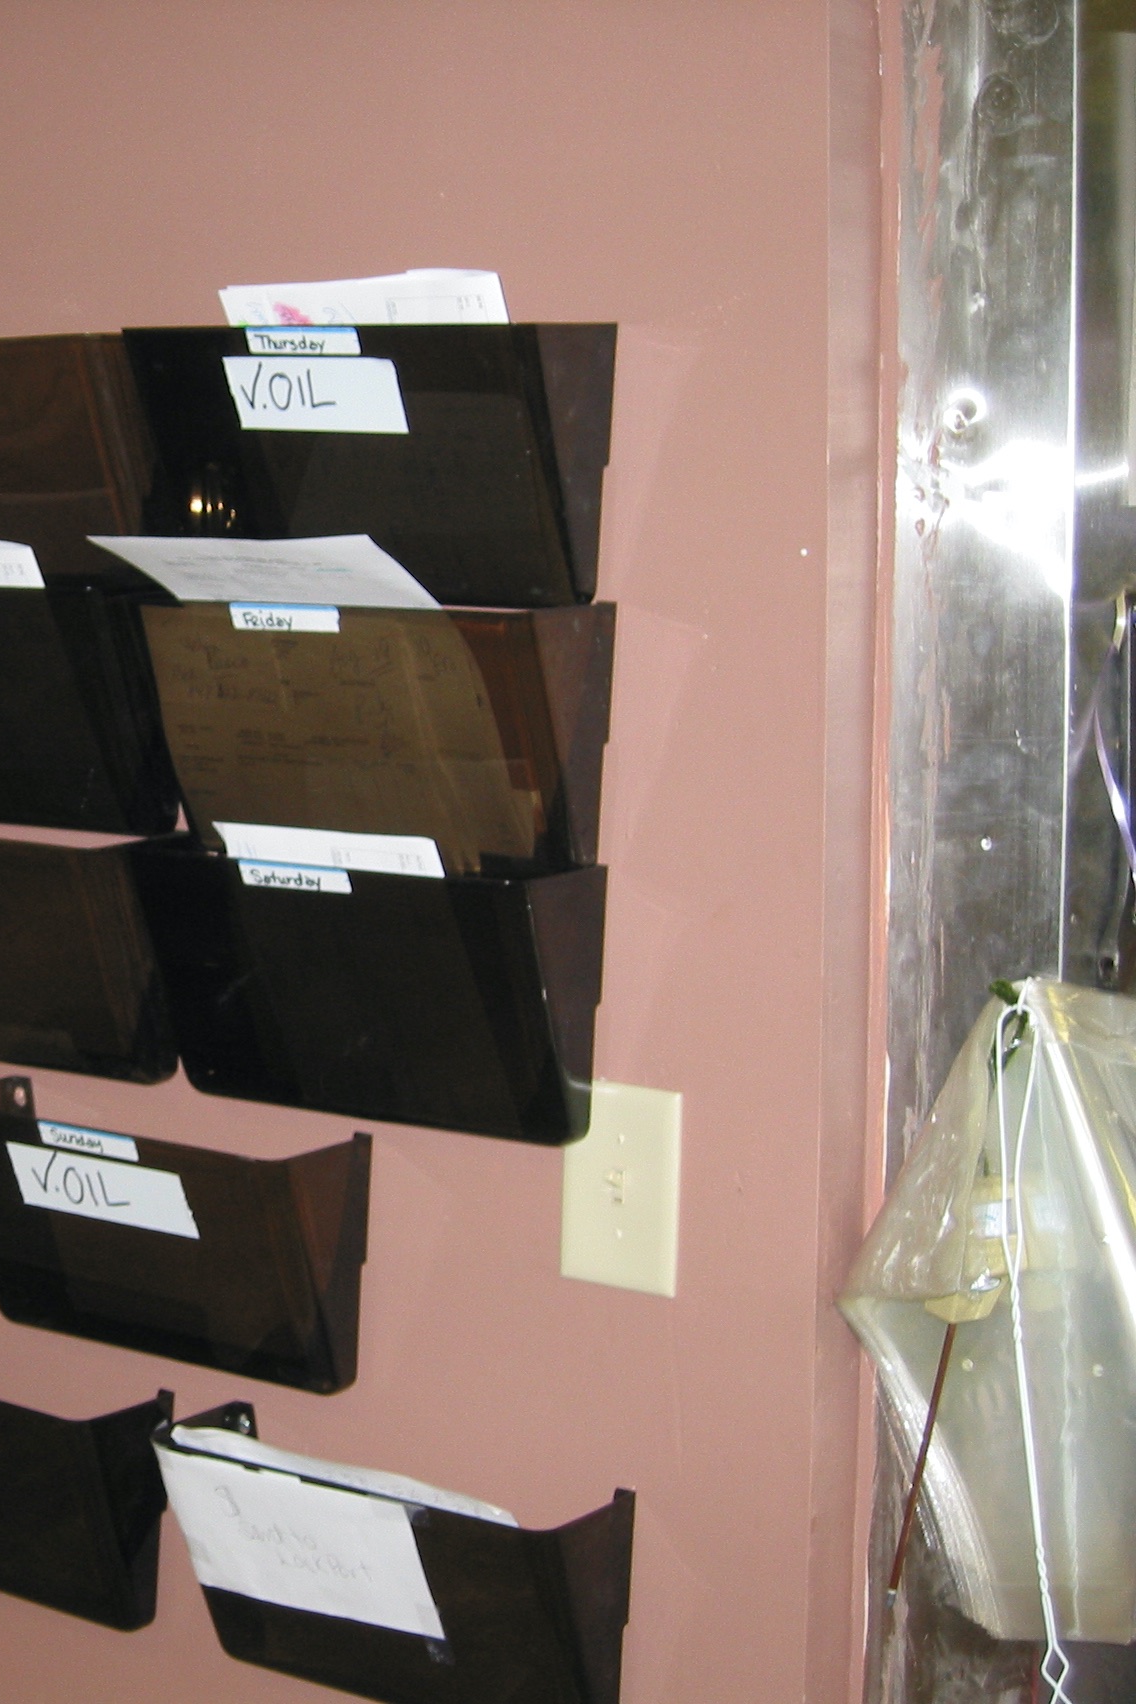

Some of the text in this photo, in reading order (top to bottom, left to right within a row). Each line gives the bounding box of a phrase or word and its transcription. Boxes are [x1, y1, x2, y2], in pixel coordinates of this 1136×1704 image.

[254, 334, 325, 353] Thursday
[243, 614, 293, 631] Friday
[250, 869, 322, 890] Saturday
[50, 1127, 104, 1153] Sunday
